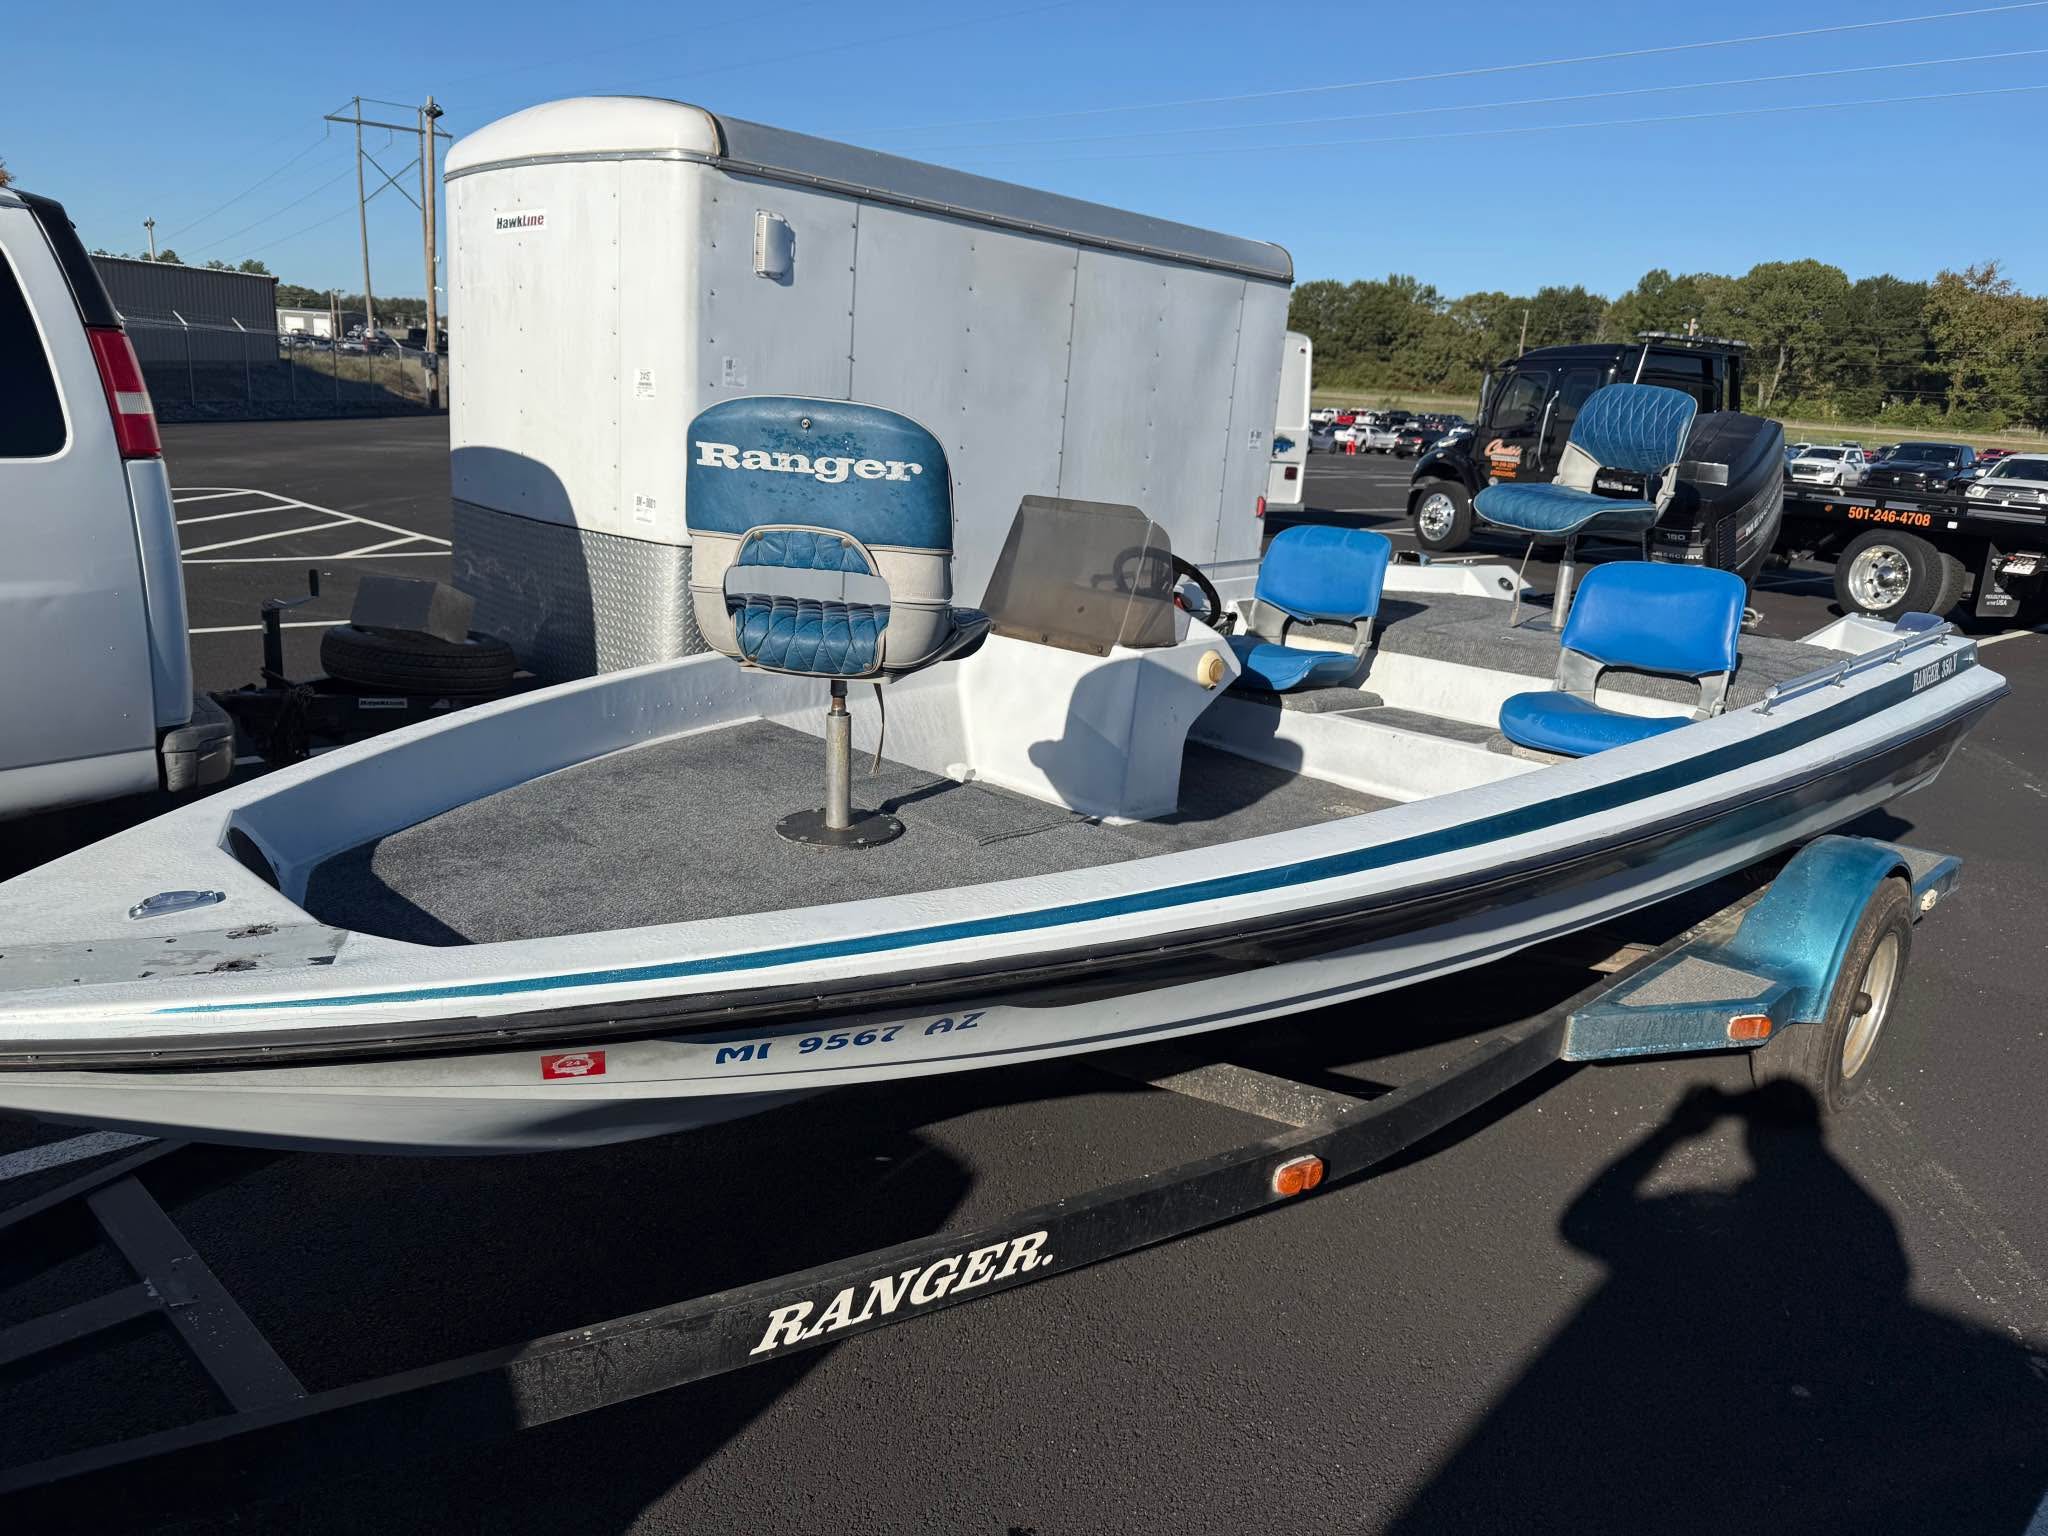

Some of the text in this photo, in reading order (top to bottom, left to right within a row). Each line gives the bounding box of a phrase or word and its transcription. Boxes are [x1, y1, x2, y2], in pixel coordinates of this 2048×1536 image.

[696, 441, 922, 483] Ranger
[1848, 506, 1931, 526] 501-246-4708
[715, 1011, 986, 1064] MI 9567 AZ
